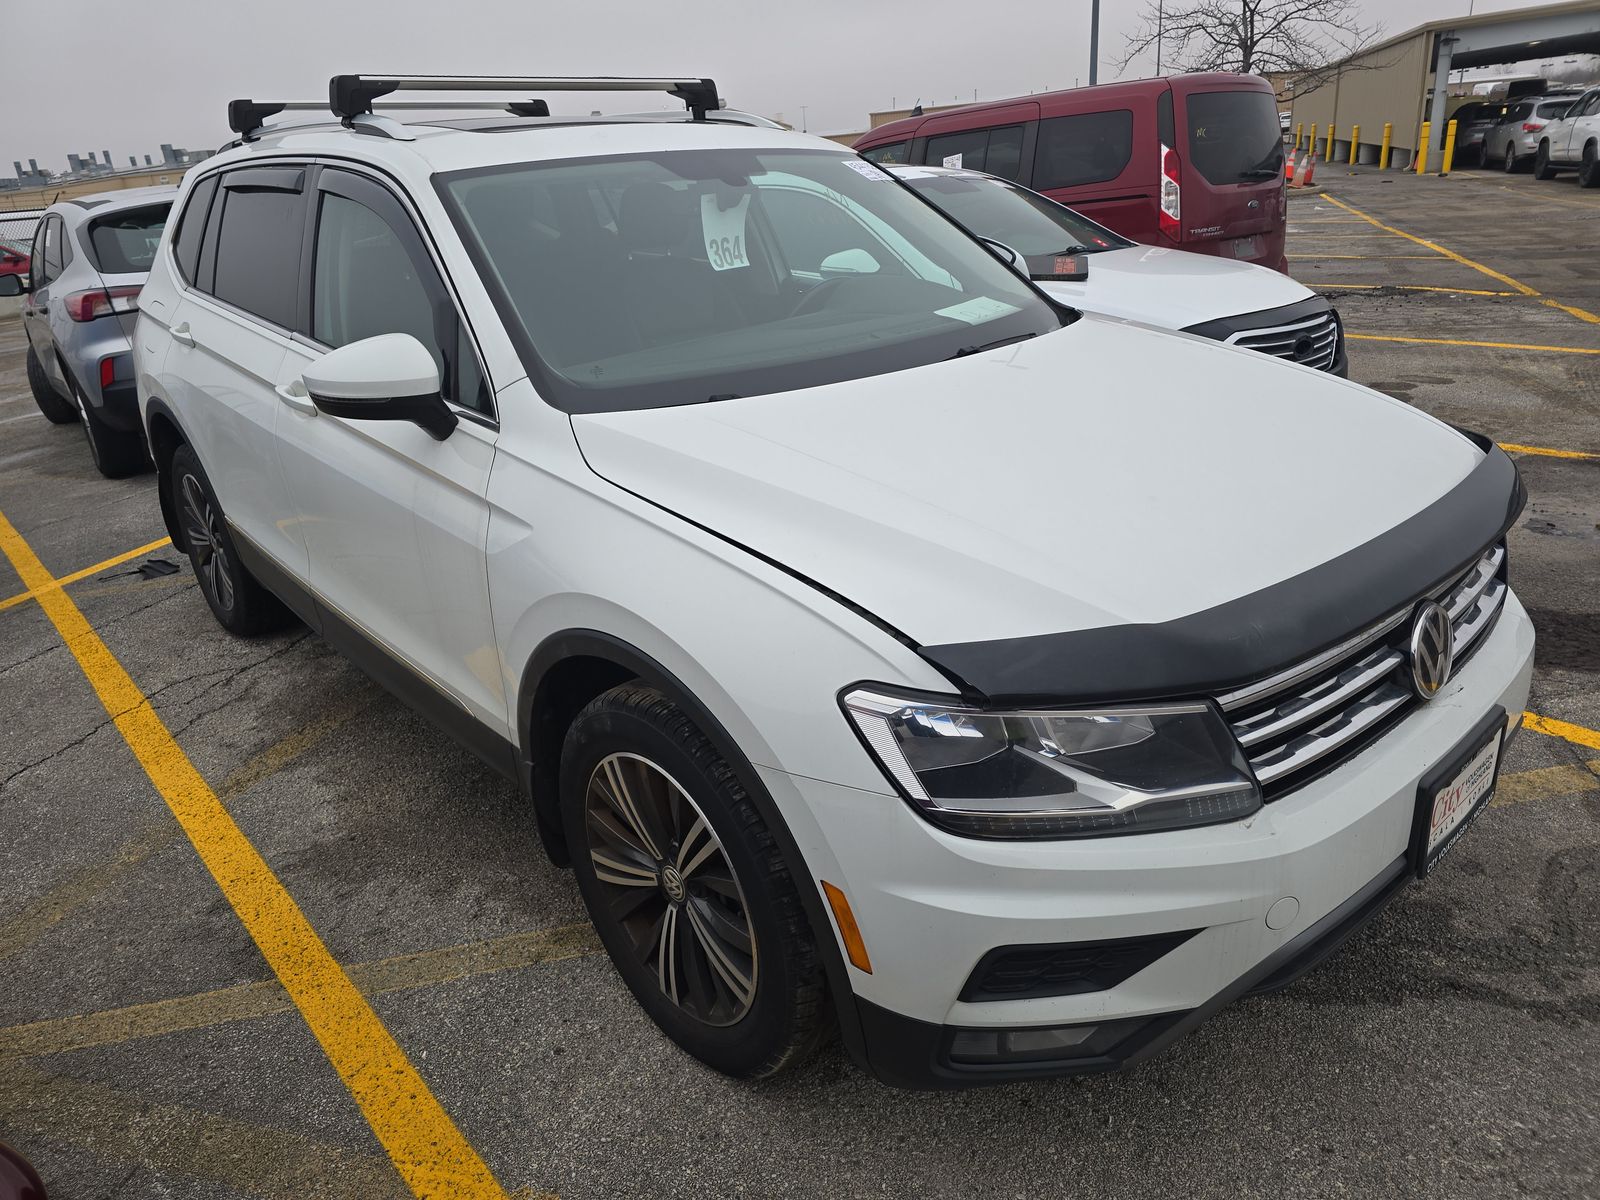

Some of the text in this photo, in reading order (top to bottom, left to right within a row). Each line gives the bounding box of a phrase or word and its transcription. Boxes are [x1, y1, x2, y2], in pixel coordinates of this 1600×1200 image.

[1190, 226, 1221, 234] TRANSIT
[709, 235, 744, 268] 364
[1466, 752, 1495, 785] VOLKSWAGEN
[1432, 785, 1465, 828] City
[1427, 858, 1439, 873] CITY
[1438, 824, 1468, 859] VOLKSWAGEN
